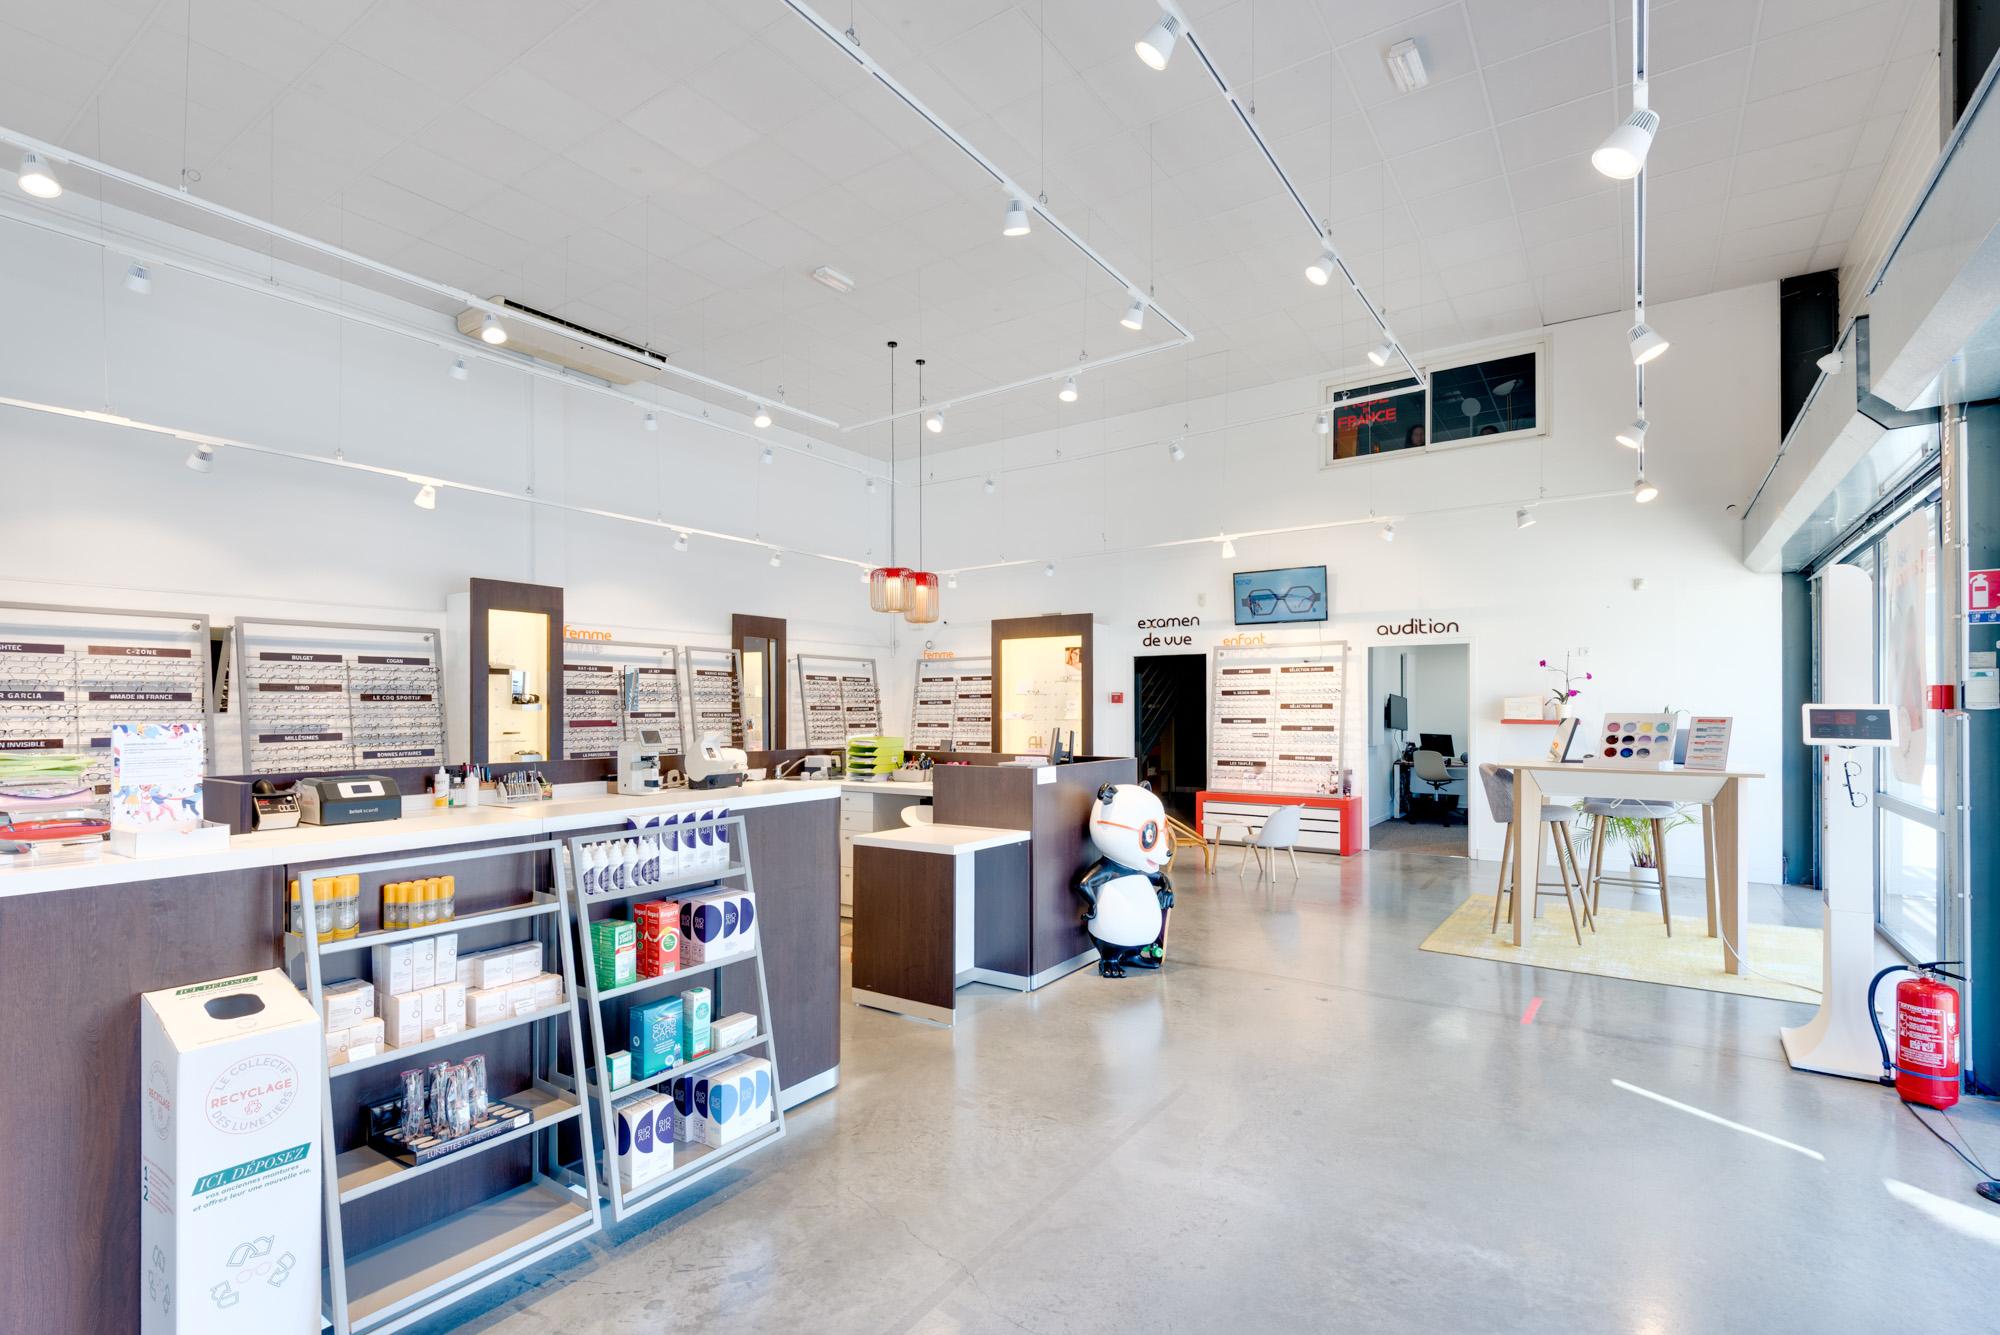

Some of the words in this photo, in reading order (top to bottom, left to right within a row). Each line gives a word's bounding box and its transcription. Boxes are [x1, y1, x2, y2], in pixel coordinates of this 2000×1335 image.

[1338, 408, 1396, 428] FRANCE
[1943, 465, 1950, 490] de
[1138, 615, 1200, 630] examen
[1376, 618, 1459, 636] audition
[563, 624, 612, 640] femme
[1223, 632, 1266, 646] enfant
[1142, 634, 1161, 647] de
[1164, 634, 1192, 646] vue
[215, 1076, 230, 1091] LE
[230, 1057, 292, 1076] COLLECTIF
[211, 1078, 292, 1109] RECYCLAGE
[212, 1110, 231, 1128] DES
[232, 1090, 294, 1131] LUNETIERS
[659, 1117, 671, 1126] BIO
[659, 1124, 670, 1133] AIR
[638, 1126, 650, 1135] BIO
[638, 1133, 650, 1142] AIR
[427, 1142, 461, 1159] LUNETTES
[144, 1166, 148, 1181] 1
[198, 1172, 227, 1192] ICI,
[231, 1147, 304, 1181] DÉPOSEZ
[203, 1196, 228, 1209] offrez
[230, 1189, 246, 1199] leur
[248, 1185, 263, 1193] une
[264, 1173, 297, 1187] nouvelle
[299, 1168, 312, 1176] vie.
[206, 1190, 219, 1199] vos
[221, 1177, 261, 1194] anciennes
[263, 1165, 299, 1179] montures
[144, 1186, 148, 1202] 2
